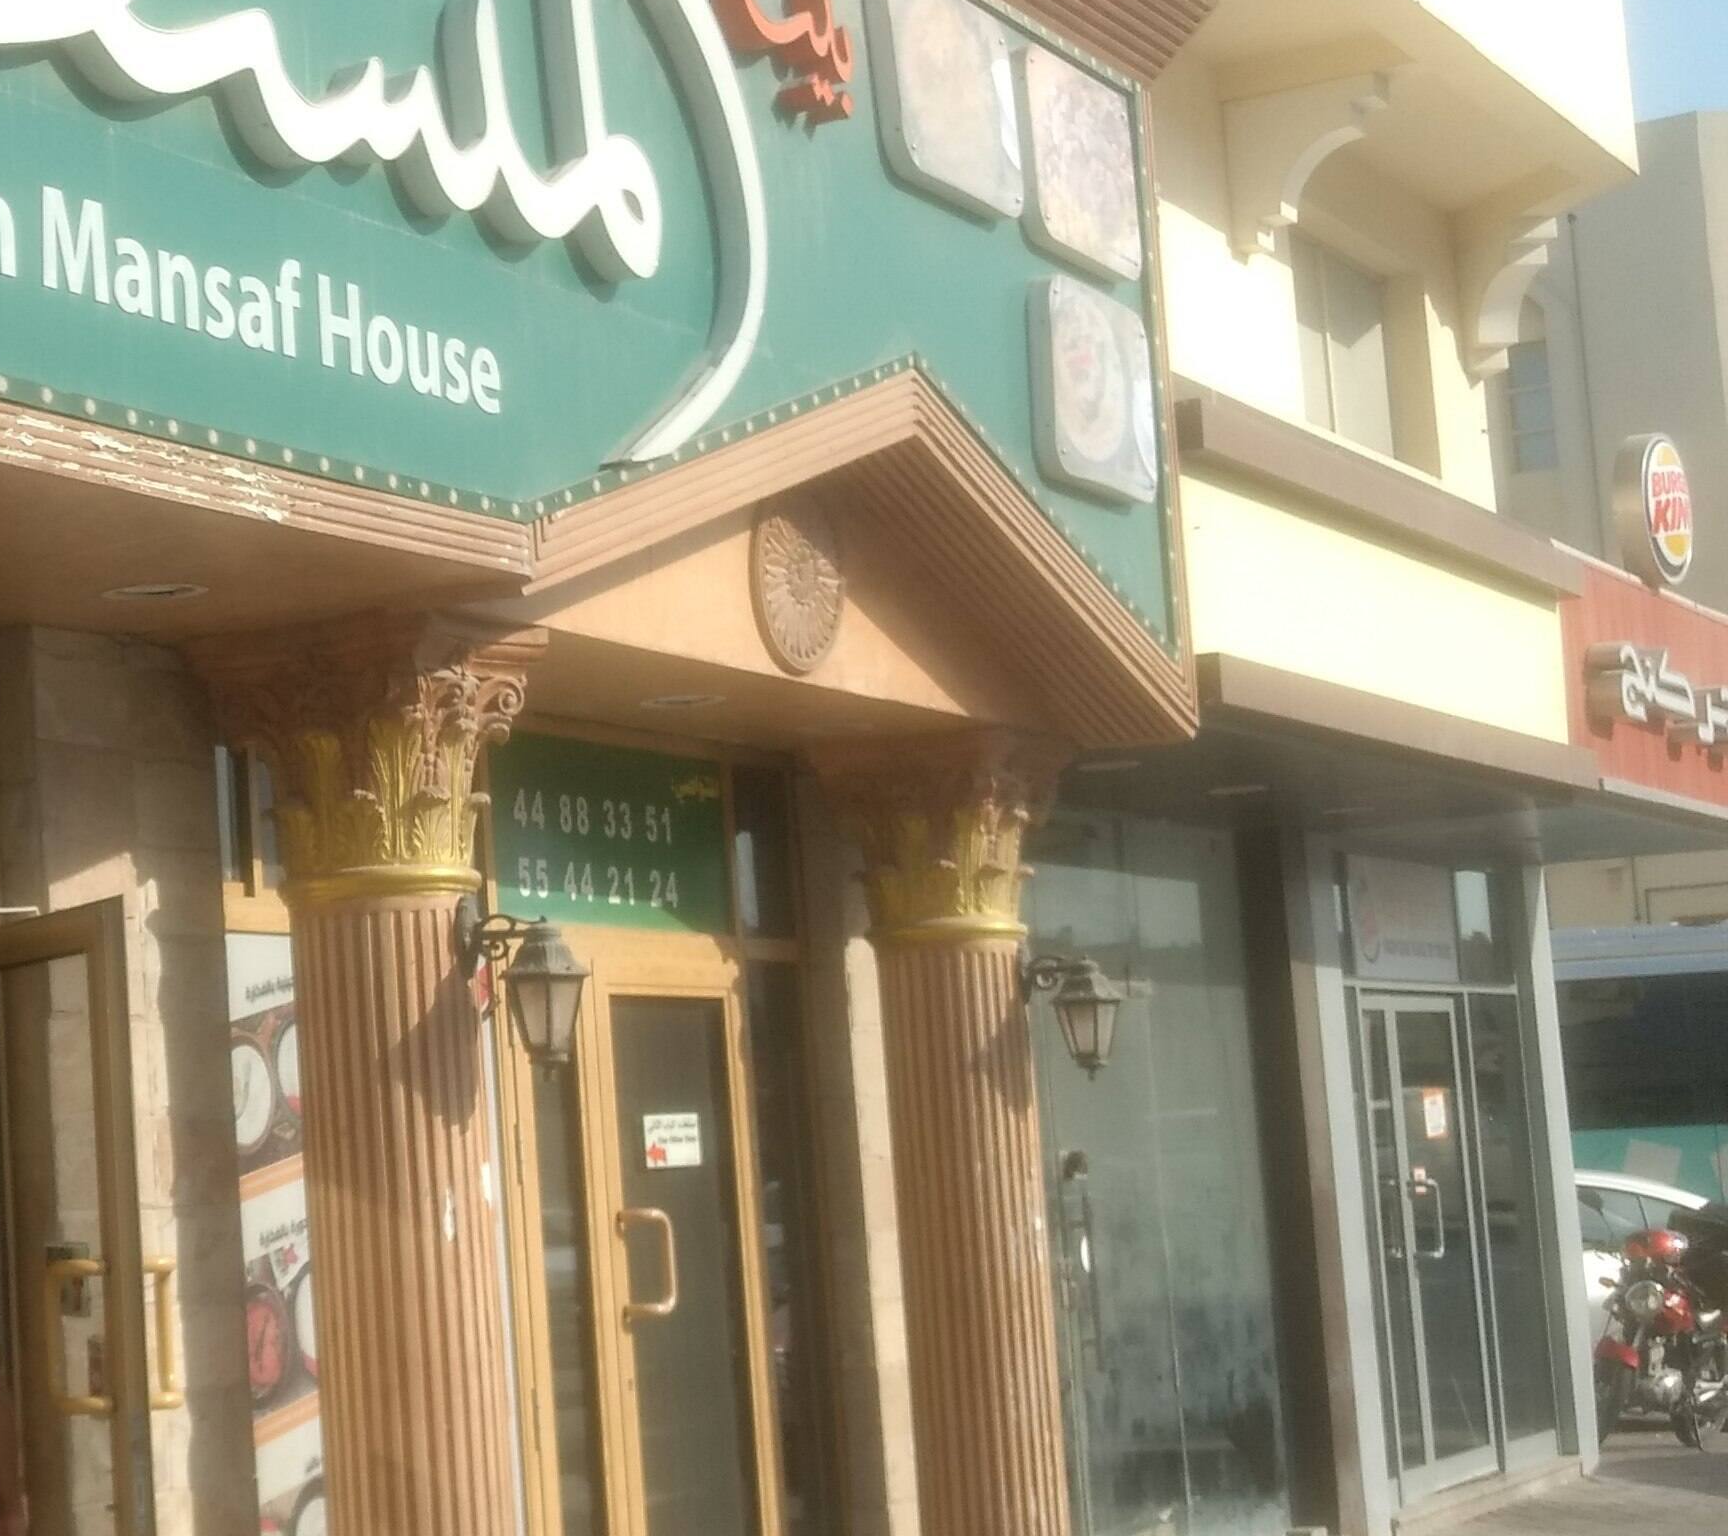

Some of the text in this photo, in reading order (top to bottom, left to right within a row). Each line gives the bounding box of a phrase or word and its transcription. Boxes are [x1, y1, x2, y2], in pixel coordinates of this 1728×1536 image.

[41, 185, 304, 358] Mansaf
[317, 272, 502, 415] House
[513, 787, 673, 847] 44 88 33 51
[518, 855, 680, 909] 55 44 21 24
